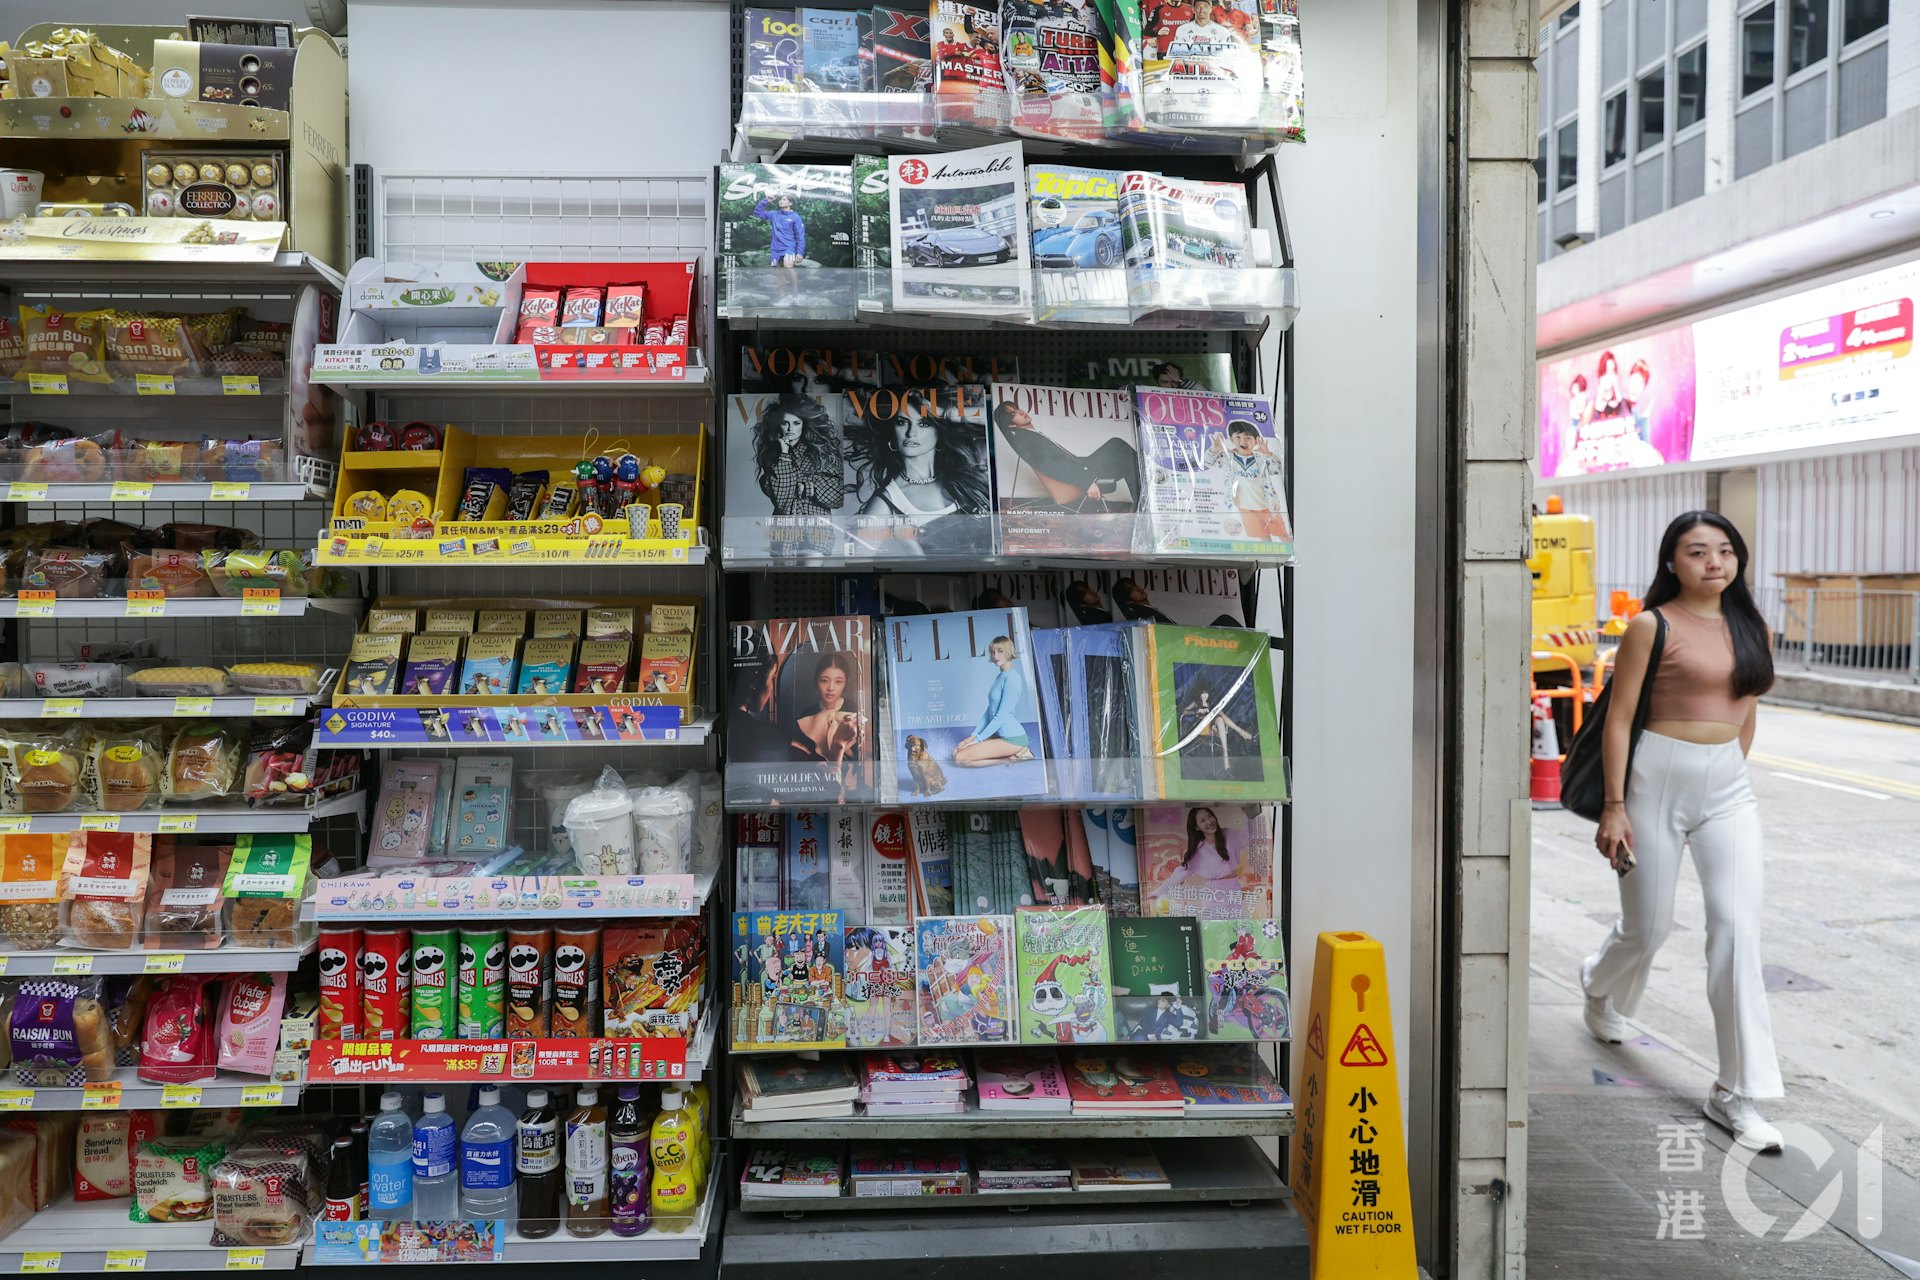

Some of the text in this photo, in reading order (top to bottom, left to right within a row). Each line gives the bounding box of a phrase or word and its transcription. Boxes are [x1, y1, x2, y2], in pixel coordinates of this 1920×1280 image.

[762, 17, 804, 37] foo
[1042, 29, 1099, 49] TURB
[303, 122, 340, 164] FERRERO
[901, 161, 928, 183] 車主
[931, 157, 1014, 181] Automobile
[1035, 172, 1118, 199] TopGe
[186, 191, 232, 202] FERRERO
[186, 200, 232, 210] COLLECTION
[62, 221, 149, 238] Christmas
[360, 290, 385, 302] damak
[411, 290, 442, 301] 開心果
[523, 300, 555, 316] KitKat
[567, 298, 599, 316] KitKat
[610, 297, 641, 315] KitKat
[63, 330, 94, 346] Bun
[151, 345, 183, 358] Bun
[848, 388, 982, 421] VOGUE
[998, 386, 1131, 421] L'OFFICIEL
[1145, 395, 1225, 428] OURS
[1254, 412, 1267, 421] 36
[372, 612, 413, 621] GODIVA
[431, 612, 471, 621] GODIVA
[483, 613, 522, 622] GODIVA
[539, 613, 578, 622] GODIVA
[592, 611, 631, 621] GODIVA
[655, 608, 692, 617] GODIVA
[357, 633, 398, 644] GODIVA
[414, 638, 455, 647] GODIVA
[472, 634, 513, 645] GODIVA
[648, 636, 688, 644] GODIVA
[736, 620, 865, 658] BAZAAR
[1184, 635, 1239, 651] FIGARO
[529, 643, 569, 651] GODIVA
[610, 696, 663, 707] GODIVA
[347, 712, 397, 722] GODIVA
[757, 774, 778, 785] THE
[779, 772, 821, 785] GOLDEN
[838, 817, 854, 849] 明報
[320, 881, 372, 889] CHIIKAWA
[774, 913, 839, 936] 老夫子 187
[944, 922, 977, 934] 大偵探
[414, 972, 445, 987] PRINGLES
[508, 970, 539, 986] PRINGLES
[555, 971, 584, 987] PRINGLES
[239, 983, 267, 1001] Wafer
[232, 996, 262, 1011] Cubes
[650, 1014, 682, 1025] 麻辣花生
[12, 1028, 73, 1042] RAISIN BUN
[484, 1056, 499, 1072] 送
[85, 1137, 124, 1148] Sandwich
[522, 1133, 555, 1150] 烏龍茶
[1348, 1086, 1381, 1209] 小心地滑
[84, 1147, 109, 1156] Bread
[656, 1144, 682, 1160] C.C.
[612, 1152, 638, 1166] Ribena
[372, 1170, 389, 1182] ion
[79, 1182, 89, 1191] 8
[136, 1179, 168, 1187] Sandwich
[372, 1178, 406, 1193] water
[136, 1187, 156, 1195] Bread
[216, 1194, 258, 1202] CRUSTLESS
[1342, 1210, 1394, 1222] CAUTION
[1335, 1222, 1402, 1236] WET FLOOR
[218, 1234, 226, 1243] 6
